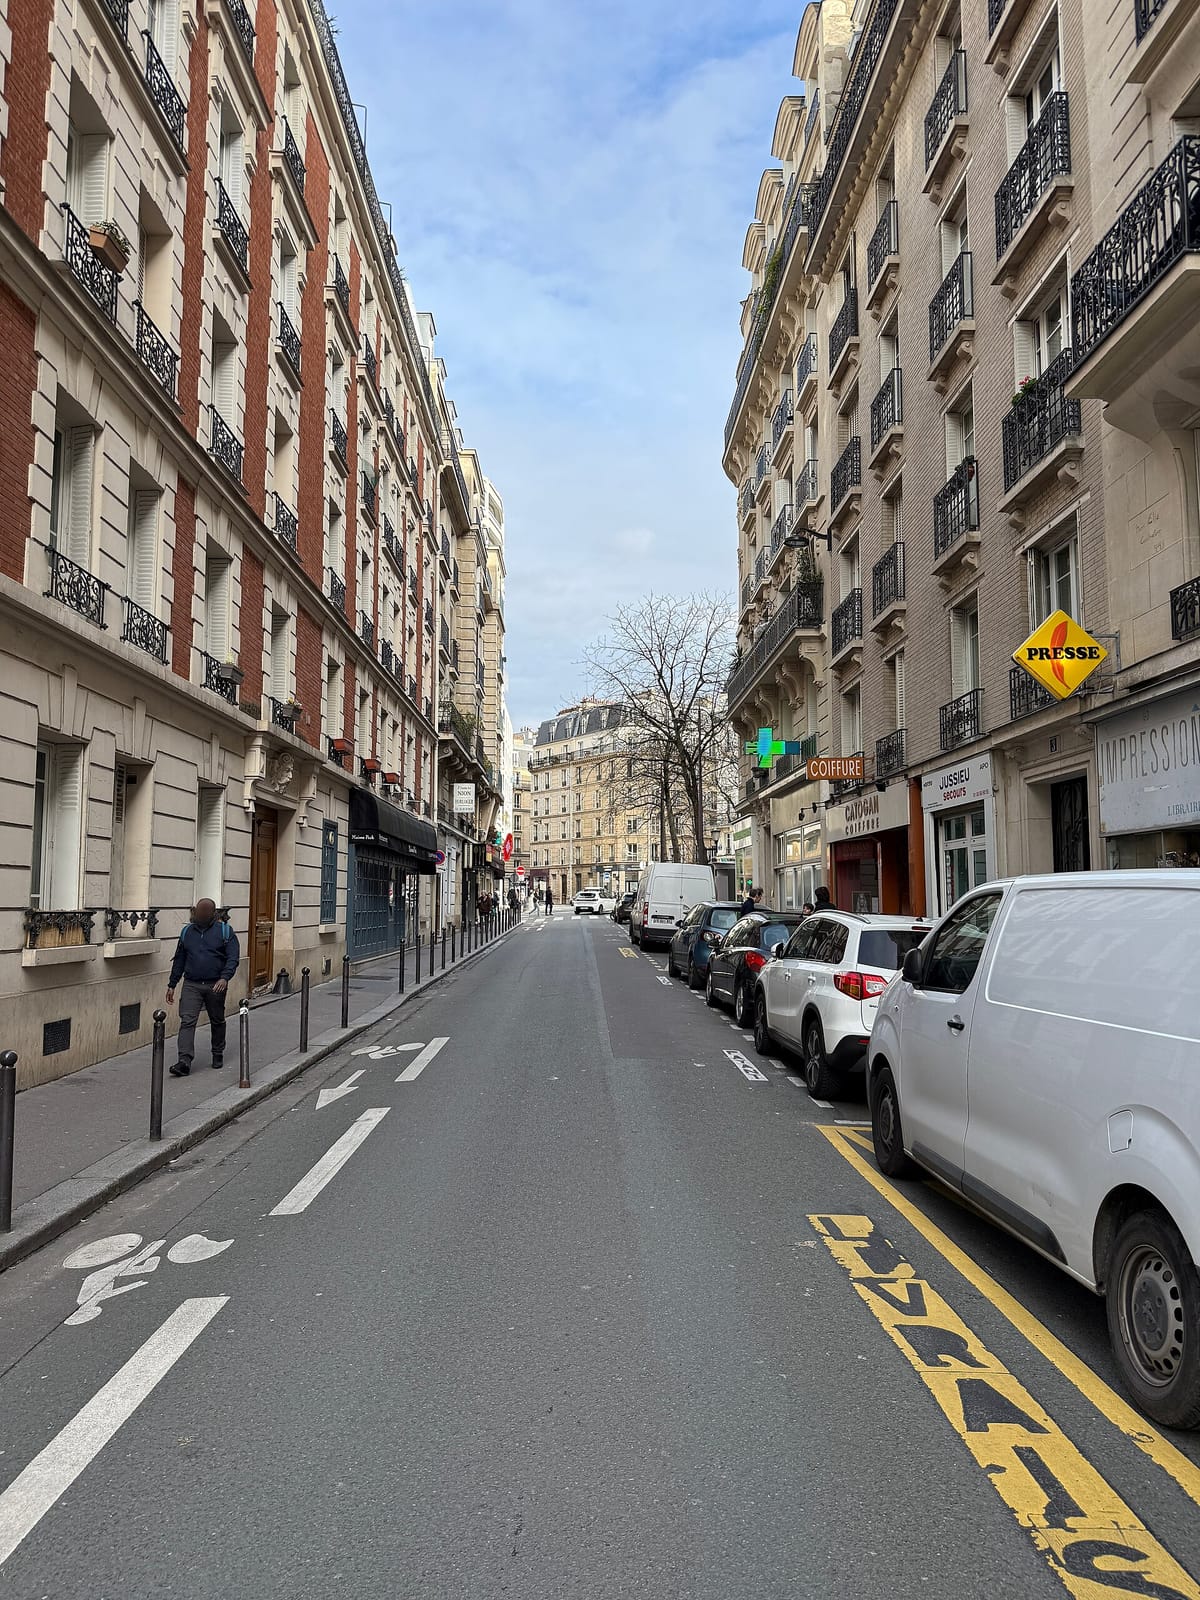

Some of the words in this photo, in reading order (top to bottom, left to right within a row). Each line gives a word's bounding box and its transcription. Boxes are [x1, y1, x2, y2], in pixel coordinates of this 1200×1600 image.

[1026, 646, 1100, 660] PRESSE
[810, 760, 861, 776] COIFFURE
[939, 767, 970, 790] JUSSIEU
[943, 786, 967, 801] secours
[845, 795, 880, 822] CATOGAN
[845, 817, 880, 836] COIFFURE
